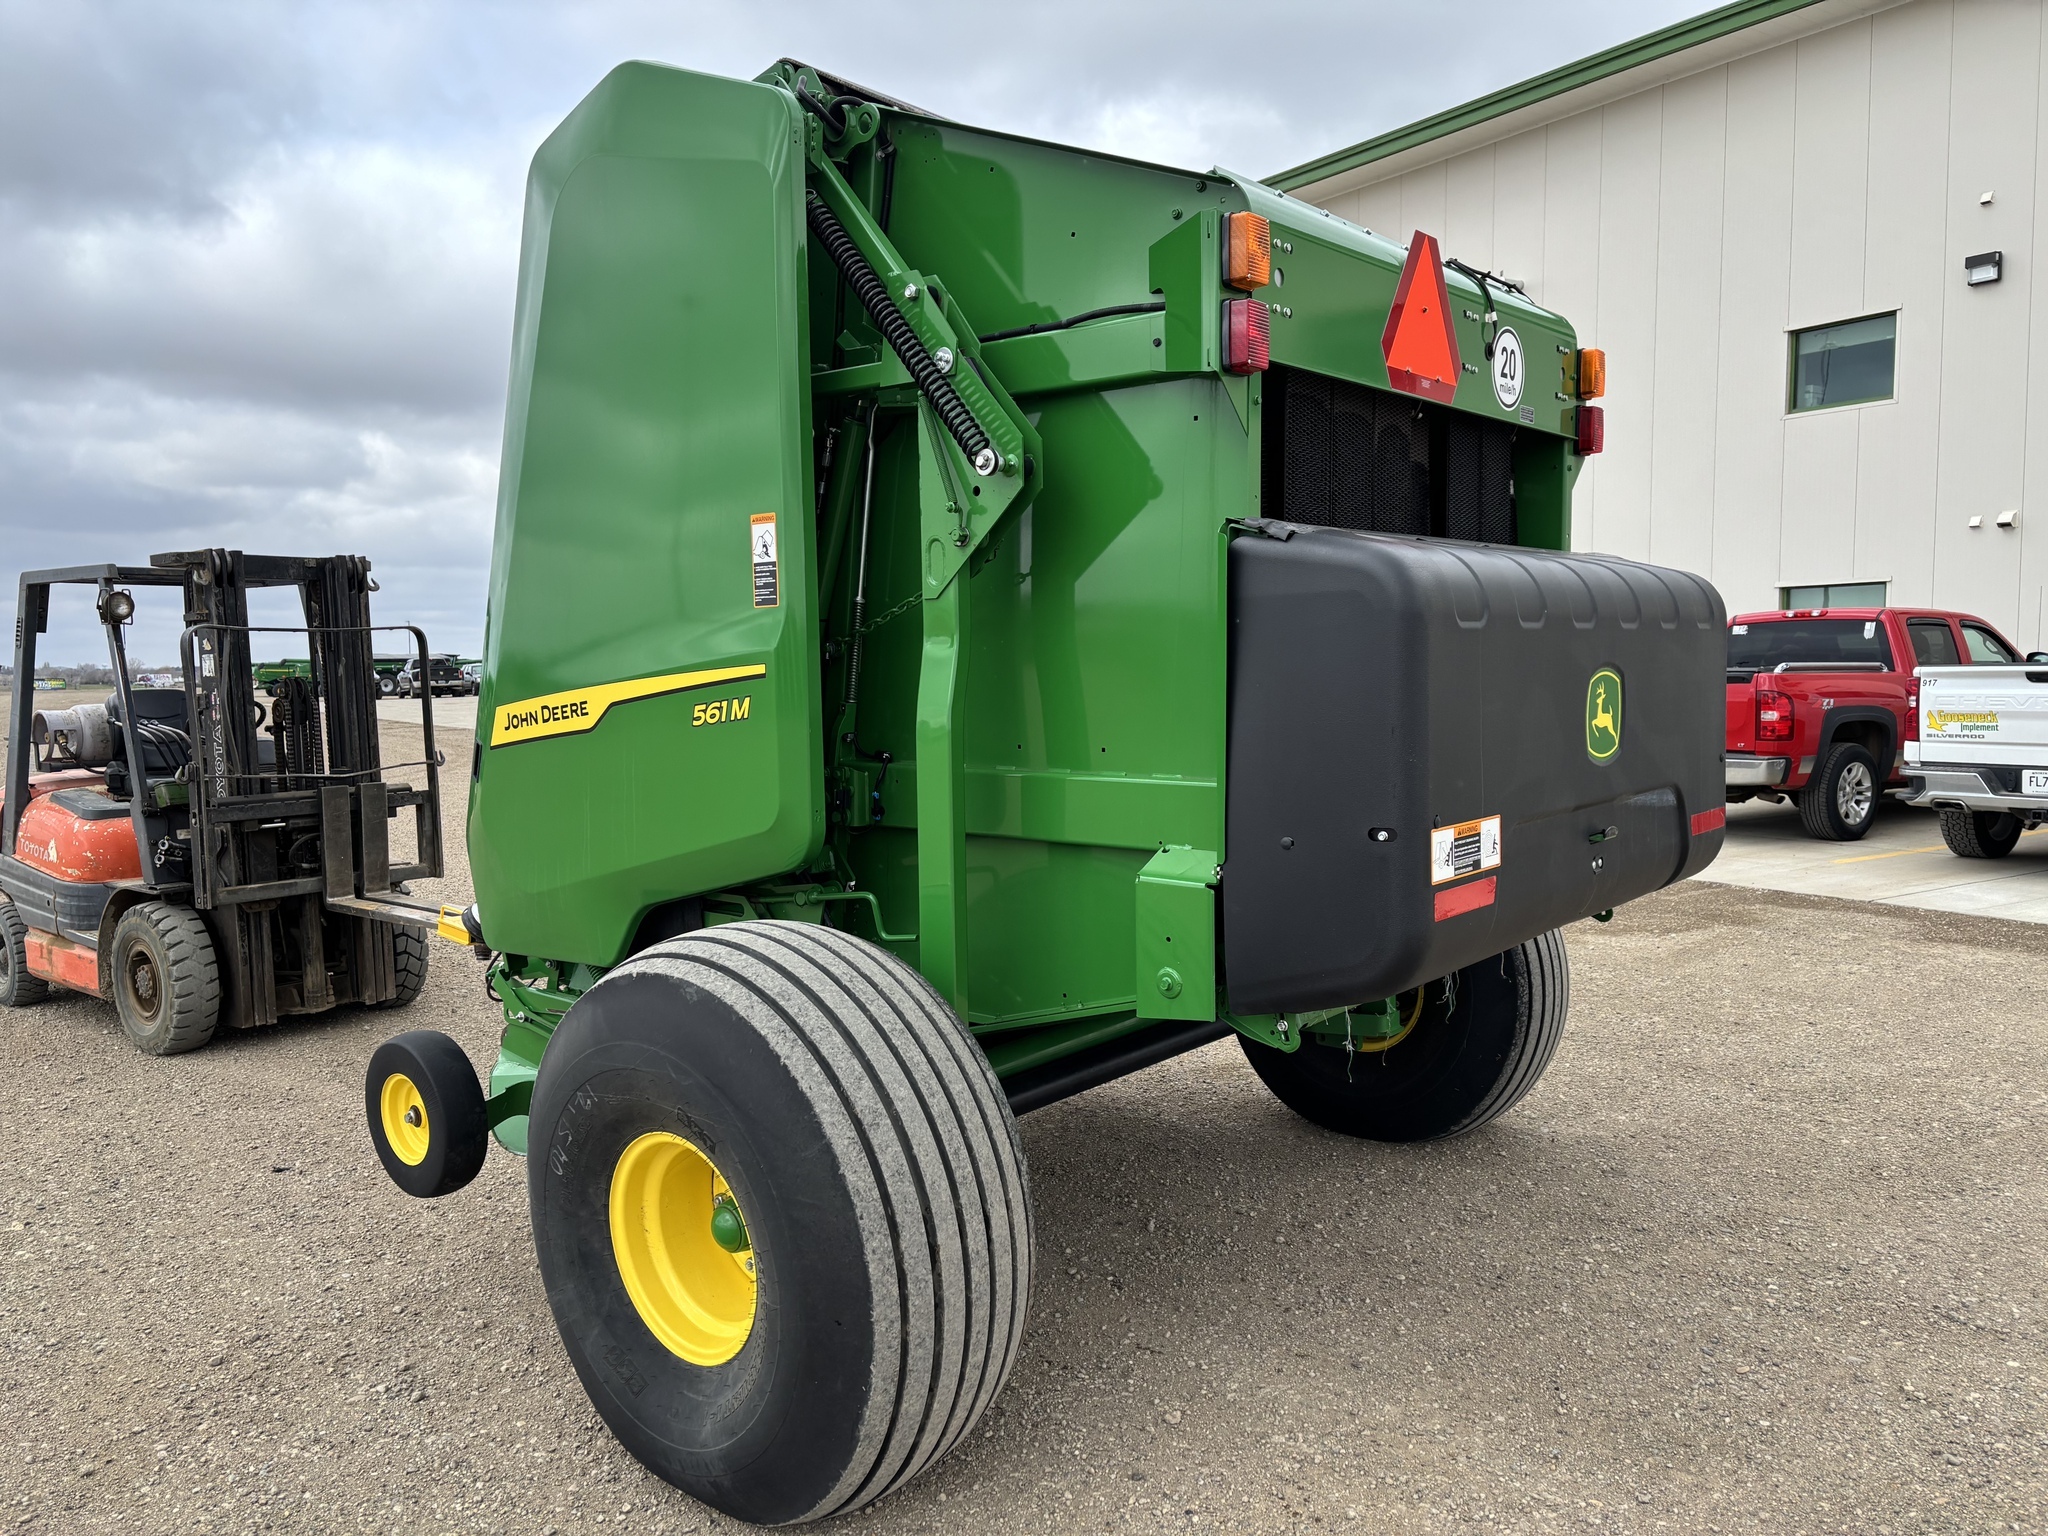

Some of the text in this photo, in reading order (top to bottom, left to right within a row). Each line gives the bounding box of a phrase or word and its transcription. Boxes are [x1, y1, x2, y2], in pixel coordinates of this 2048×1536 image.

[1500, 346, 1516, 382] 20
[1500, 382, 1516, 396] mile/h
[755, 515, 775, 523] WARNING
[1922, 679, 1938, 687] 917
[504, 700, 589, 732] JOHN DEERE
[1937, 709, 1998, 723] Gooseneck
[1960, 723, 1999, 733] Implement
[213, 724, 227, 798] OYOTA
[1461, 825, 1478, 836] WARNING
[20, 838, 49, 863] TOYOTA
